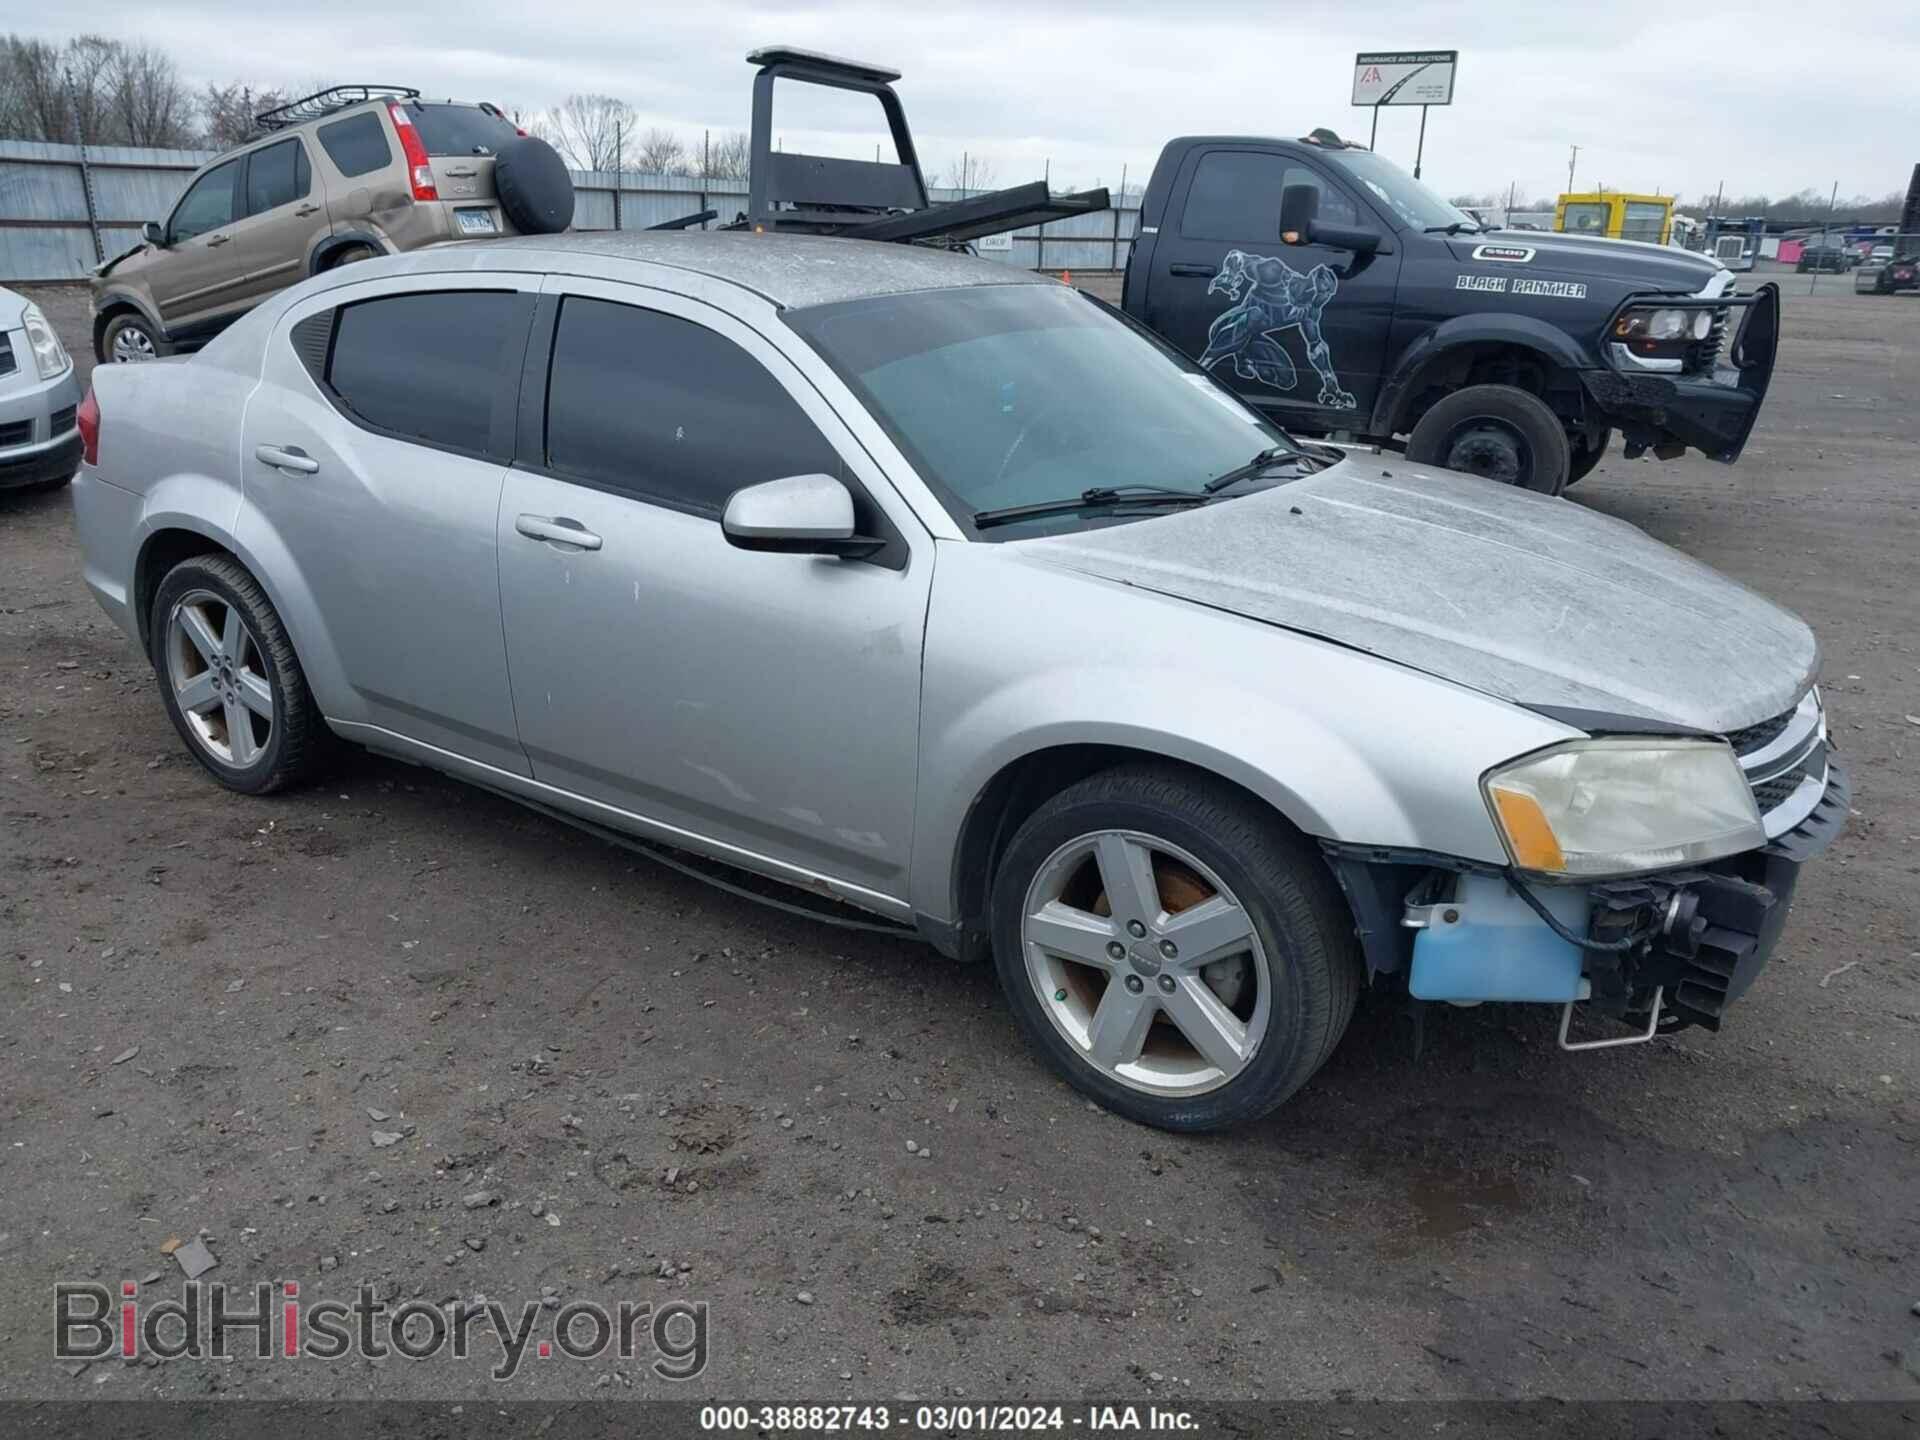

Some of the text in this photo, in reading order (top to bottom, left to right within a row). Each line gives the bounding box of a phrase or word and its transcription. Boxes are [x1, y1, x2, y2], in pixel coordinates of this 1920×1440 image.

[1398, 55, 1416, 63] AUTO
[1456, 276, 1588, 299] BLACK PANTHER
